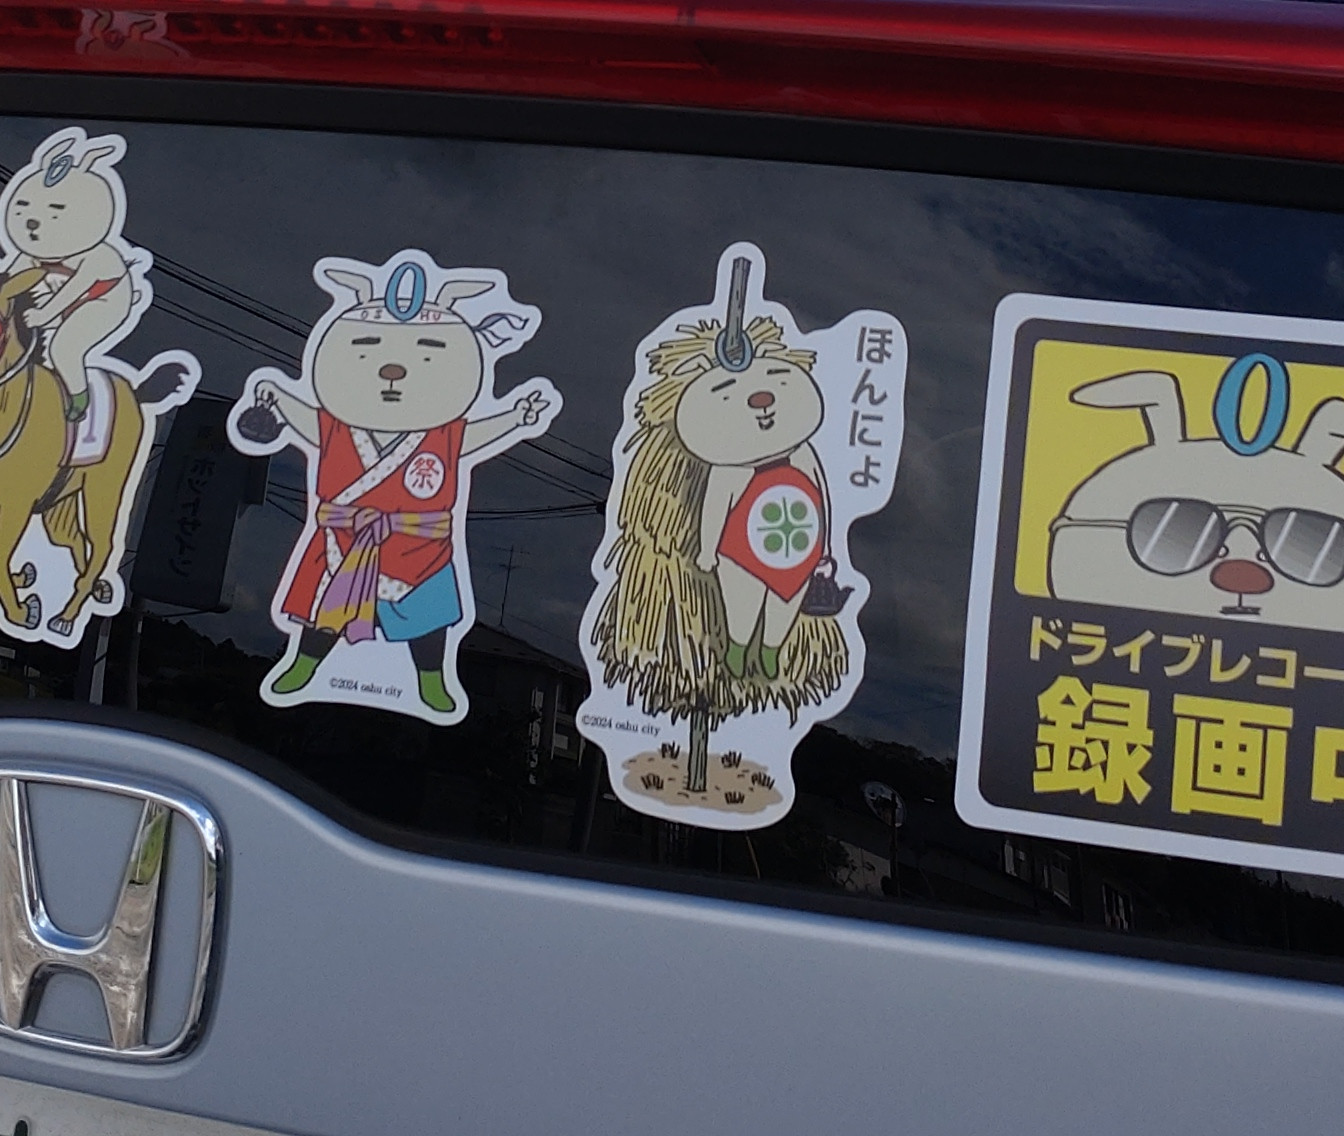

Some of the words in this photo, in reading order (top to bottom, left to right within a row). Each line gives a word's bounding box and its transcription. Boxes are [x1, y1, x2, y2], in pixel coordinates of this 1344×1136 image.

[848, 325, 893, 488] ほんにょ
[409, 456, 440, 489] 祭
